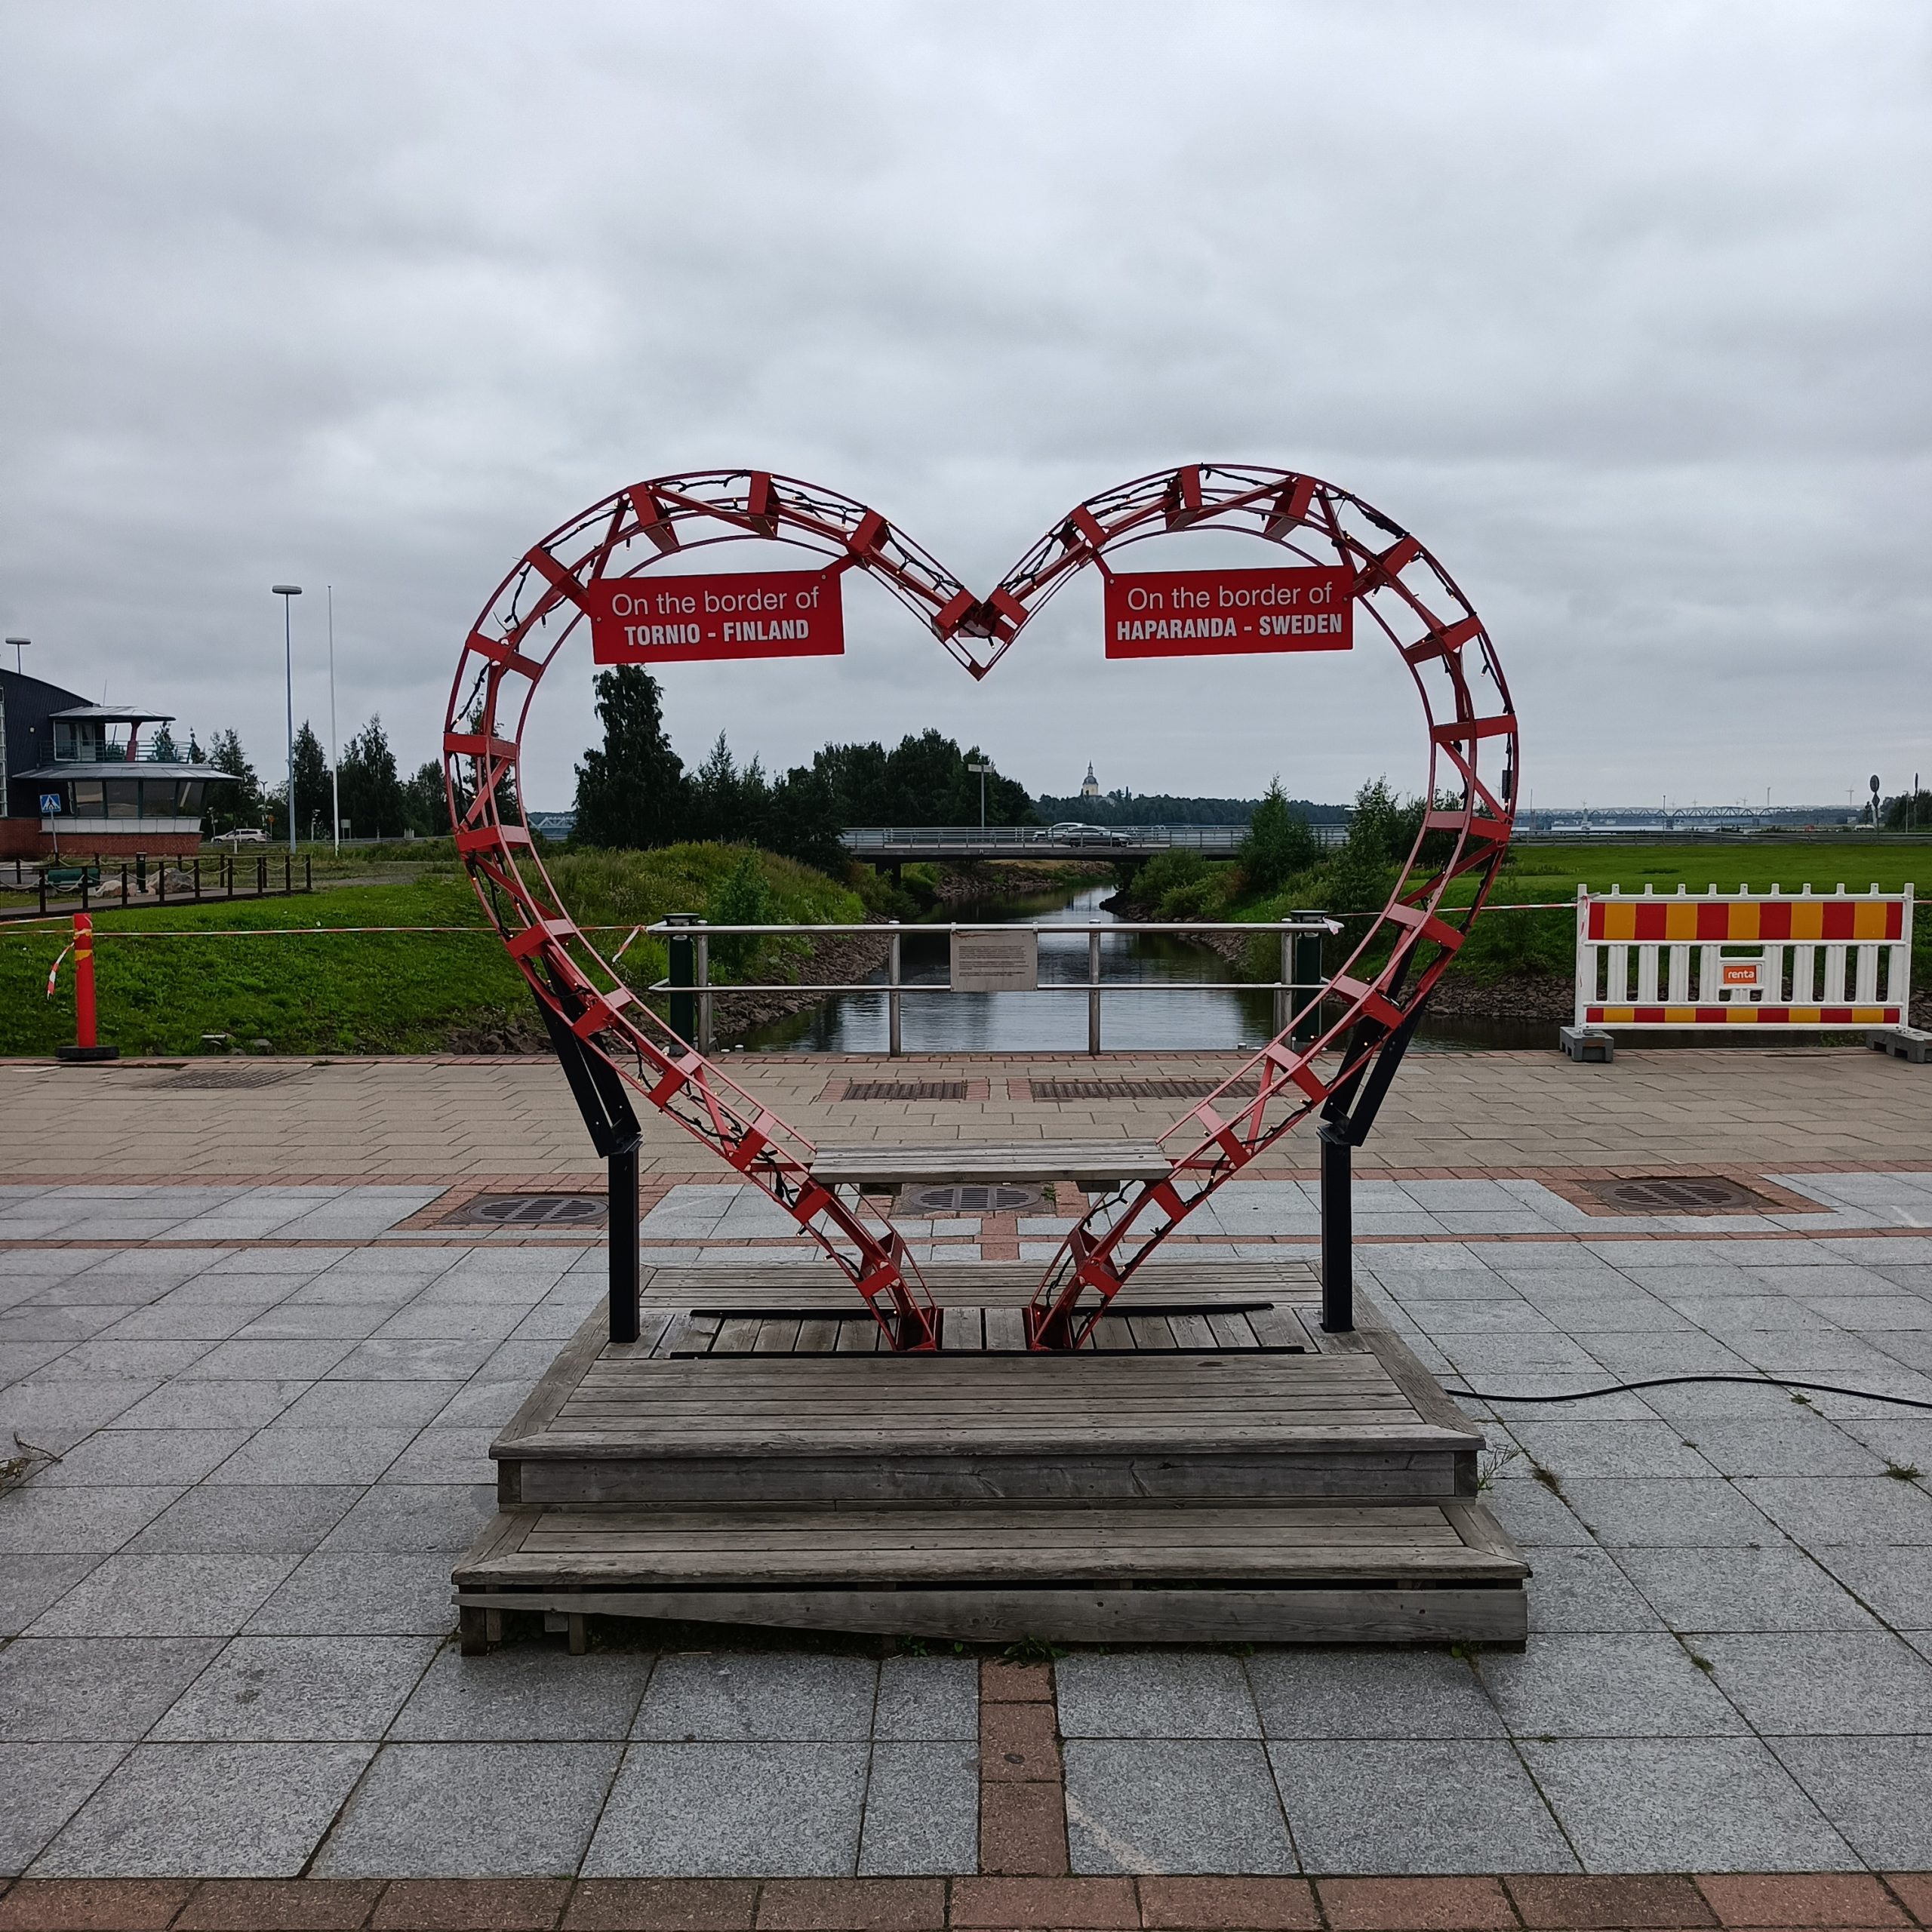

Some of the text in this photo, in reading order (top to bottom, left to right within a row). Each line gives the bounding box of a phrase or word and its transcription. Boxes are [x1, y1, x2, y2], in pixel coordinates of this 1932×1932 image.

[612, 586, 820, 617] On the border of
[1128, 581, 1333, 611] On the border of
[624, 623, 700, 646] TORNIO
[723, 619, 809, 642] FINLAND
[1117, 617, 1237, 641] HAPARANDA
[1259, 614, 1342, 635] SWEDEN
[1728, 970, 1755, 979] renta
